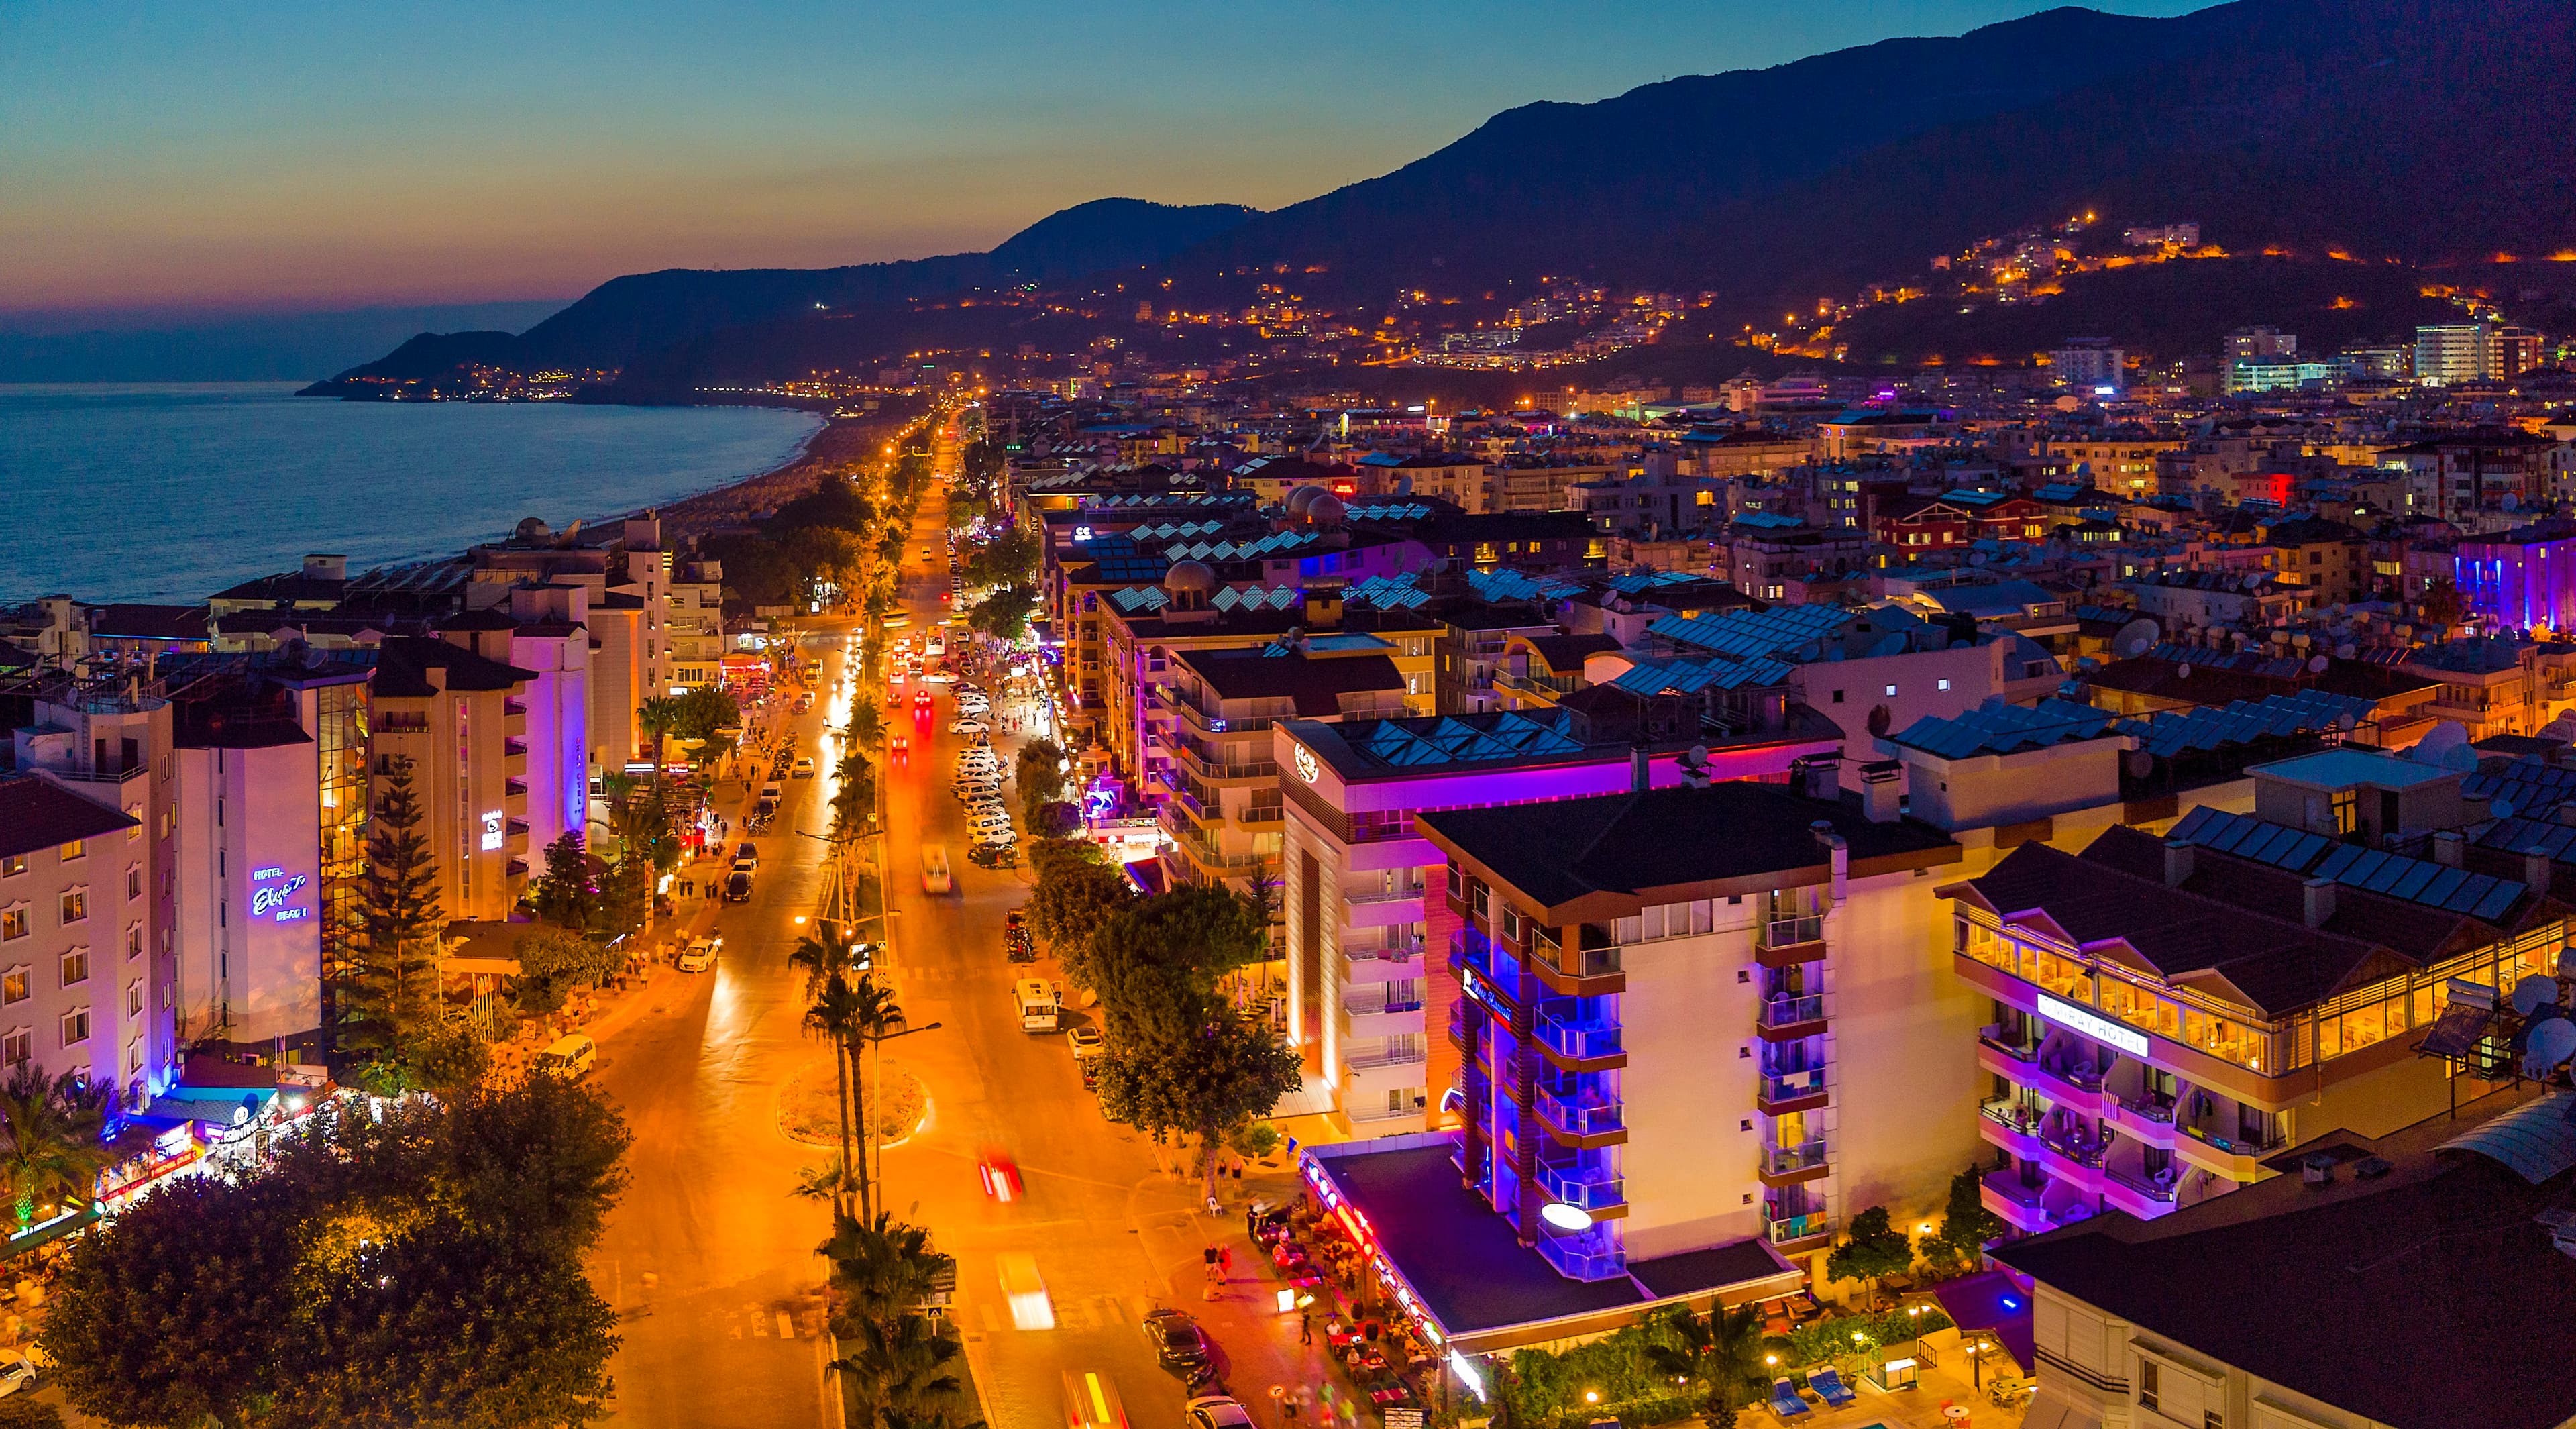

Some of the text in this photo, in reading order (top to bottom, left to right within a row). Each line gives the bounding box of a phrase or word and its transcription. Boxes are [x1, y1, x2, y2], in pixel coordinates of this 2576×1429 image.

[254, 867, 284, 880] HOTEL
[1471, 977, 1487, 1000] Blue
[2098, 1022, 2143, 1053] HOTEL
